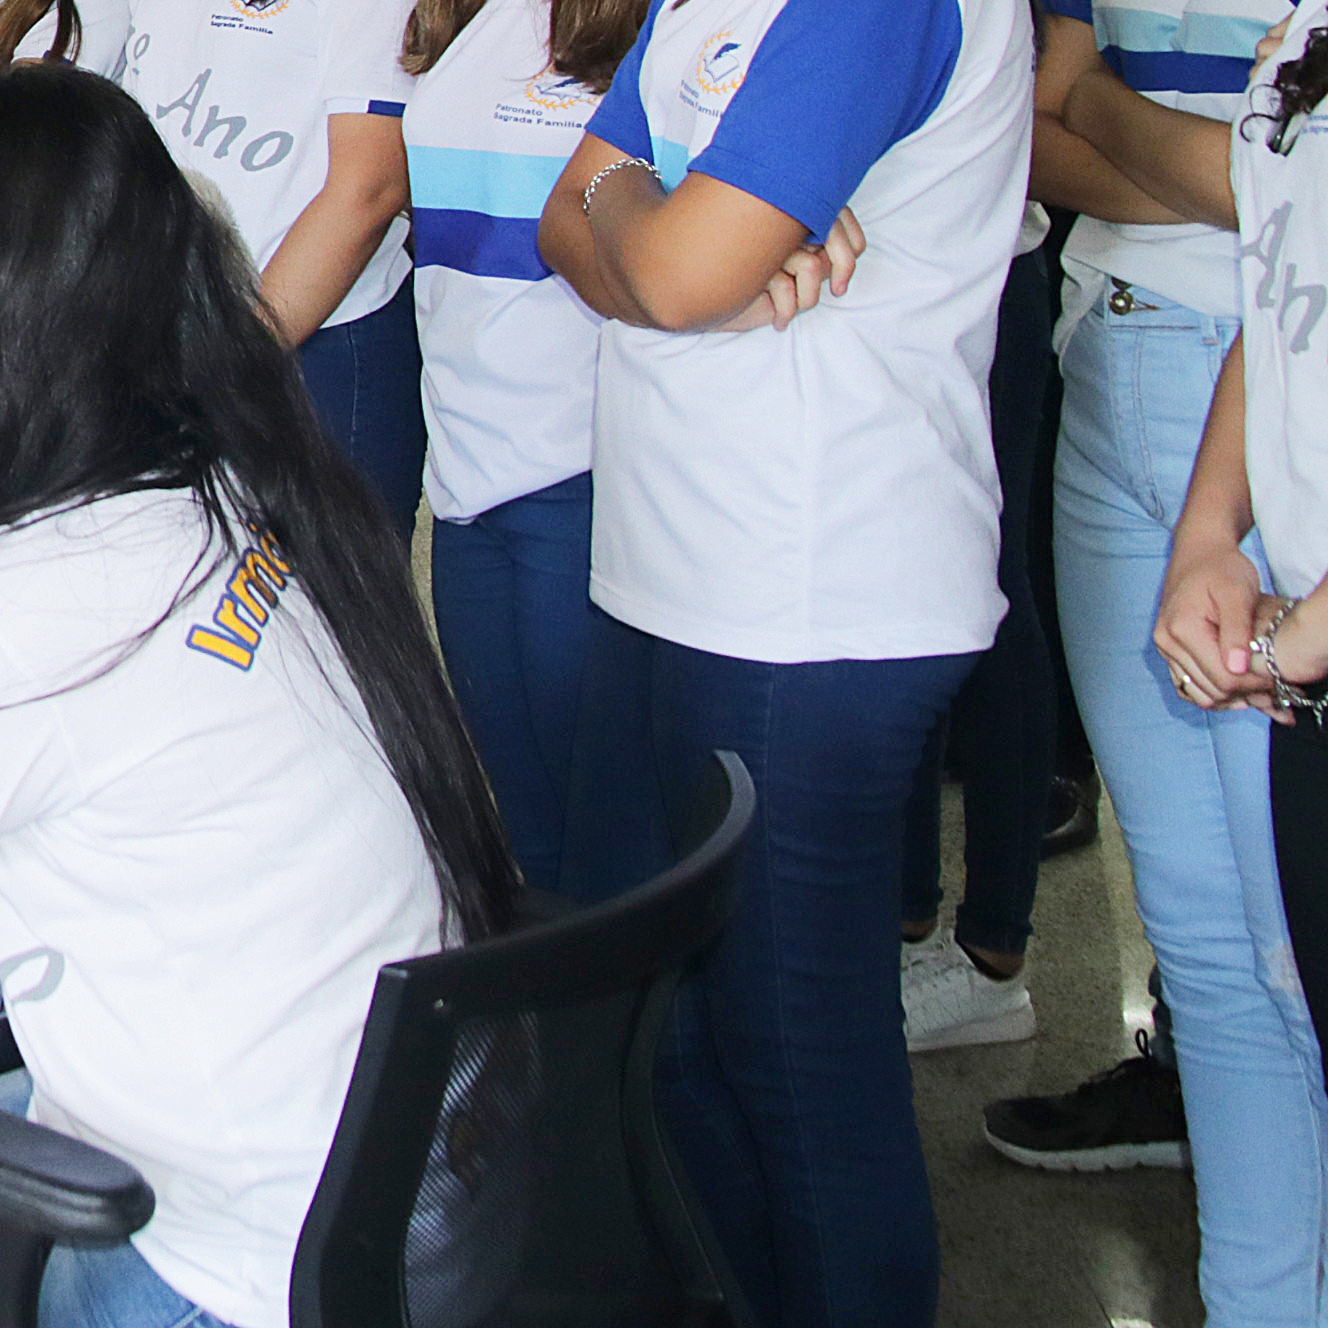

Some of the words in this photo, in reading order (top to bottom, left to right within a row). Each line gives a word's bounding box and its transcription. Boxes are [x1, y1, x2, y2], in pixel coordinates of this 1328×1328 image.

[211, 14, 244, 22] Patronato
[495, 103, 544, 117] Patronato
[156, 68, 295, 172] Ano
[493, 111, 533, 125] Sagrada
[1241, 200, 1327, 355] An
